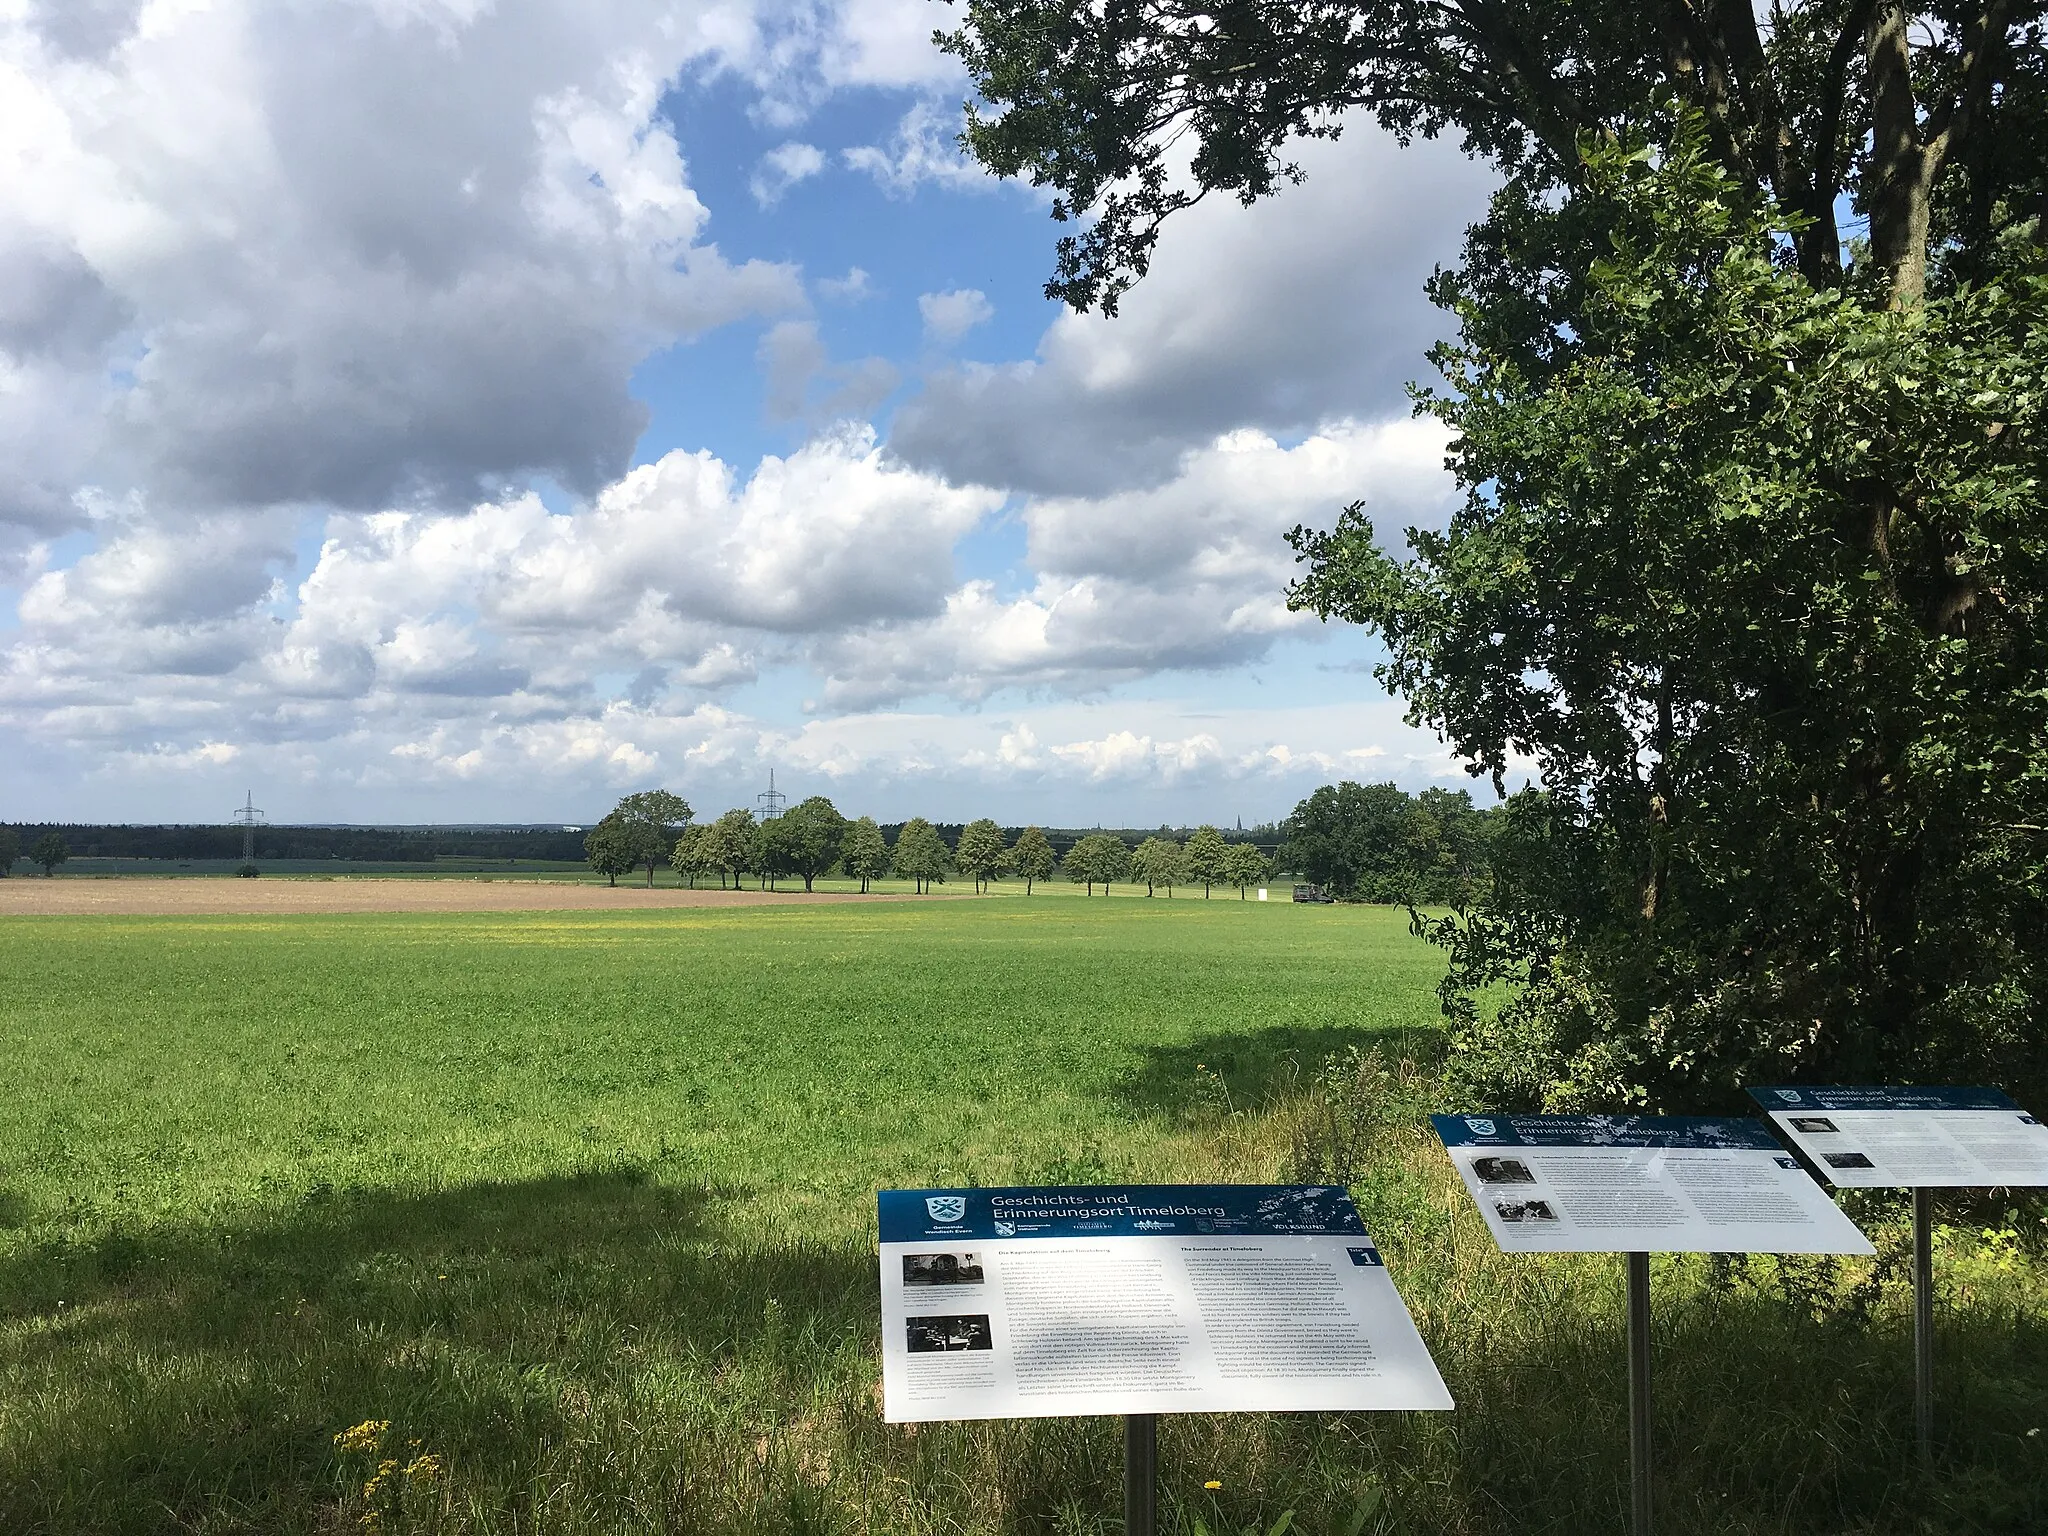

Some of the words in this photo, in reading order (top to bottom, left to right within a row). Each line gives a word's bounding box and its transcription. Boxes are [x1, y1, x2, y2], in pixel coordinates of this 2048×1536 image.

[1511, 1119, 1580, 1127] Geschichts-
[1783, 1160, 1797, 1169] 2
[991, 1195, 1090, 1206] Geschichts-
[1095, 1194, 1129, 1204] und
[993, 1206, 1124, 1219] Erinnerungsort
[1126, 1205, 1225, 1218] Timeloberg
[1361, 1252, 1375, 1265] 1
